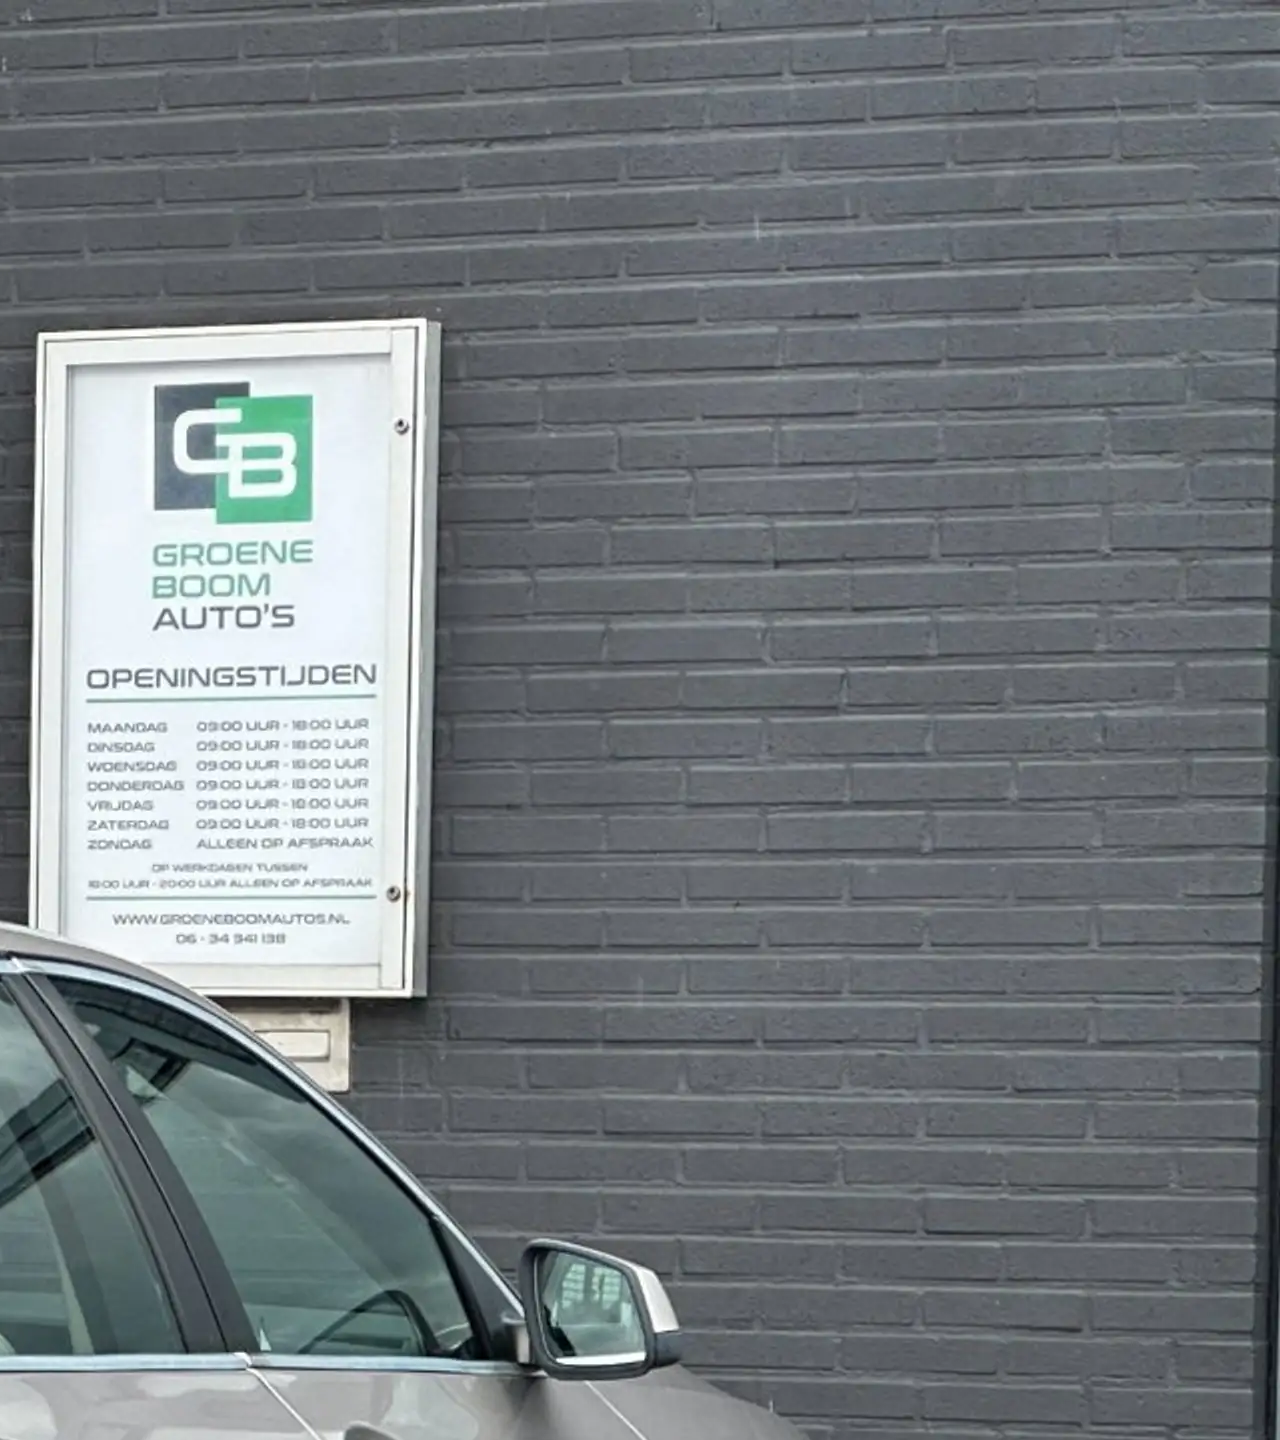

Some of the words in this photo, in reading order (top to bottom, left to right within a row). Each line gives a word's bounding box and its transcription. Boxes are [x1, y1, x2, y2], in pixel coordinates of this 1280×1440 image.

[152, 539, 314, 567] GROENE
[151, 574, 271, 599] BOOM
[152, 604, 296, 630] AUTO'S
[87, 664, 376, 689] OPENINGSTIJDEN
[88, 722, 167, 733] MAANDAG
[246, 720, 280, 731] UUR
[335, 718, 369, 729] UUR
[87, 742, 155, 753] DINSDAG
[246, 740, 280, 751] UUR
[334, 738, 369, 749] UUR
[88, 760, 177, 772] WOENSDAG
[246, 760, 279, 771] UUR
[334, 758, 369, 769] UUR
[87, 780, 184, 792] DONDERDAG
[246, 779, 279, 790] UUR
[334, 778, 369, 789] UUR
[87, 800, 154, 811] VRIJDAG
[245, 799, 279, 809] UUR
[334, 798, 369, 809] UUR
[88, 820, 169, 831] ZATERDAG
[245, 818, 279, 829] UUR
[334, 817, 369, 829] UUR
[88, 839, 152, 850] ZONDAG
[197, 838, 257, 849] ALLEEN
[261, 838, 283, 849] OP
[287, 837, 373, 849] AFSPRAAK
